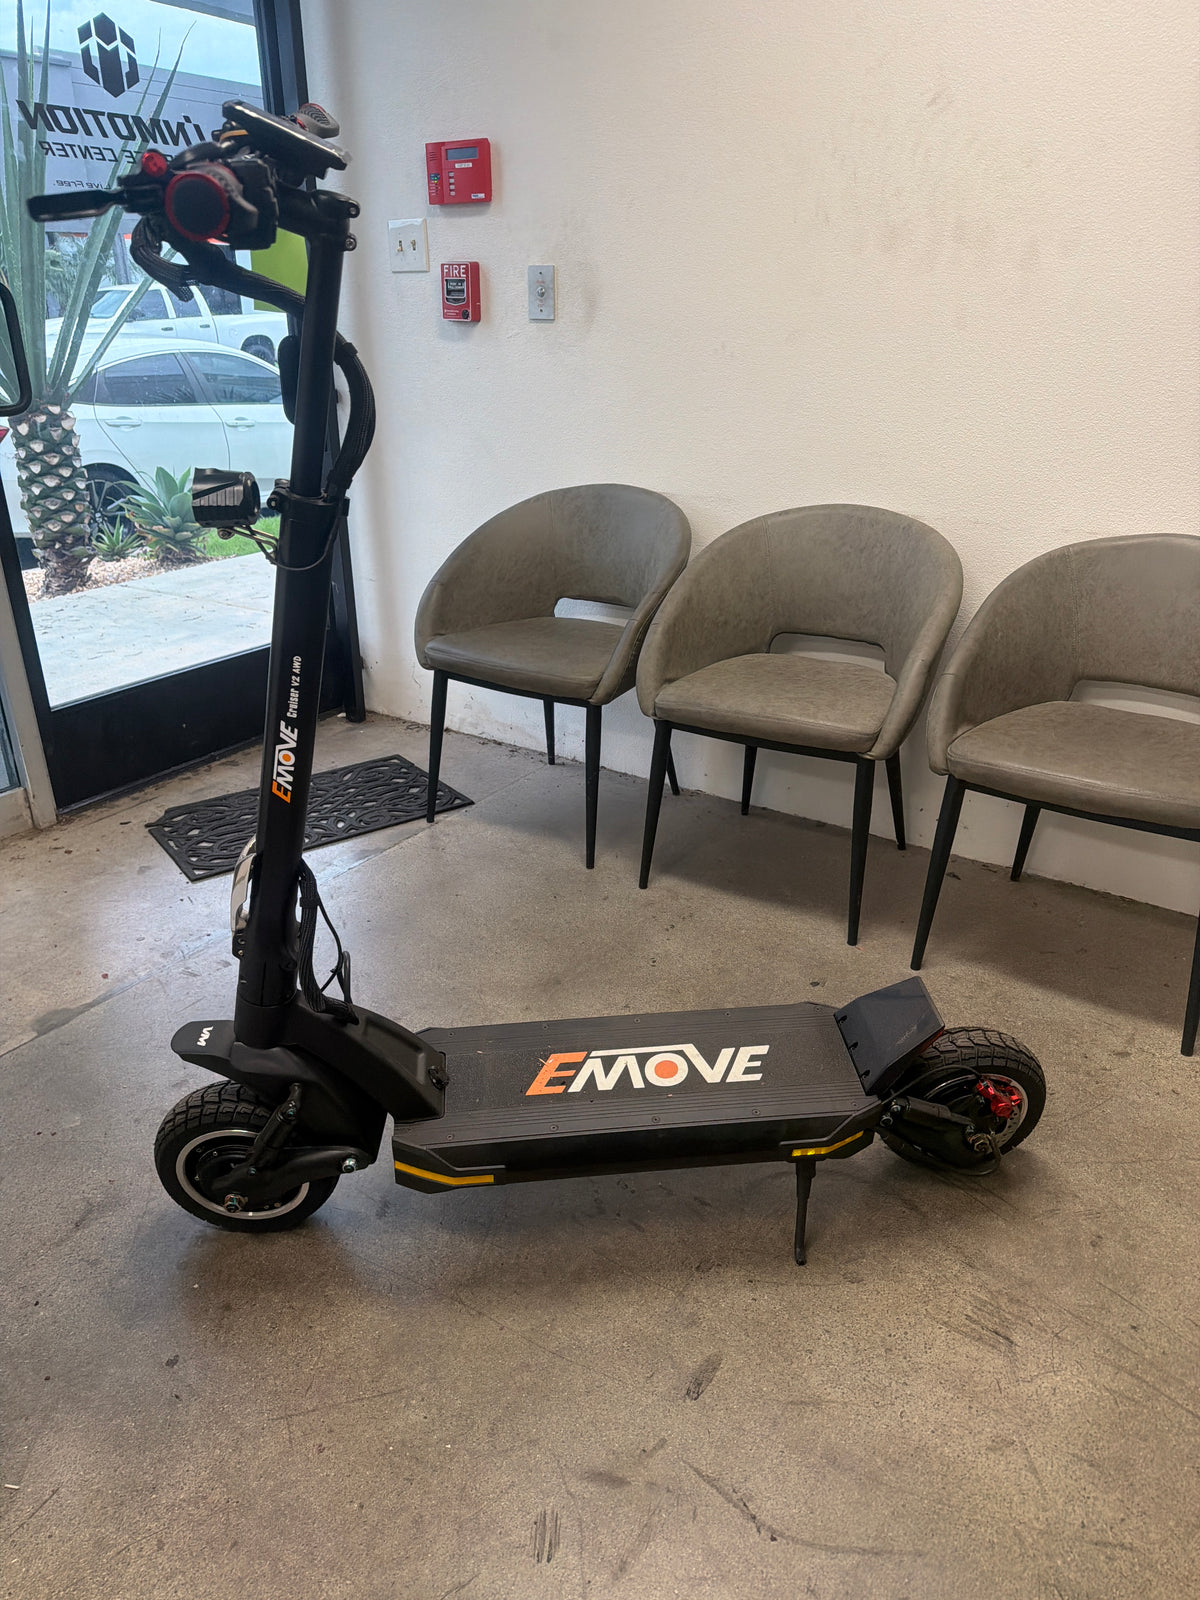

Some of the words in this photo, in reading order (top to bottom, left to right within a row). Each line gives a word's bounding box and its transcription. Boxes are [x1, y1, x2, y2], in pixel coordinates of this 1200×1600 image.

[443, 264, 467, 278] FIRE
[292, 655, 302, 675] AWD
[290, 675, 301, 687] V2
[286, 688, 300, 718] Cruiser
[271, 720, 299, 804] EMOVE
[525, 1043, 770, 1096] EMOVE
